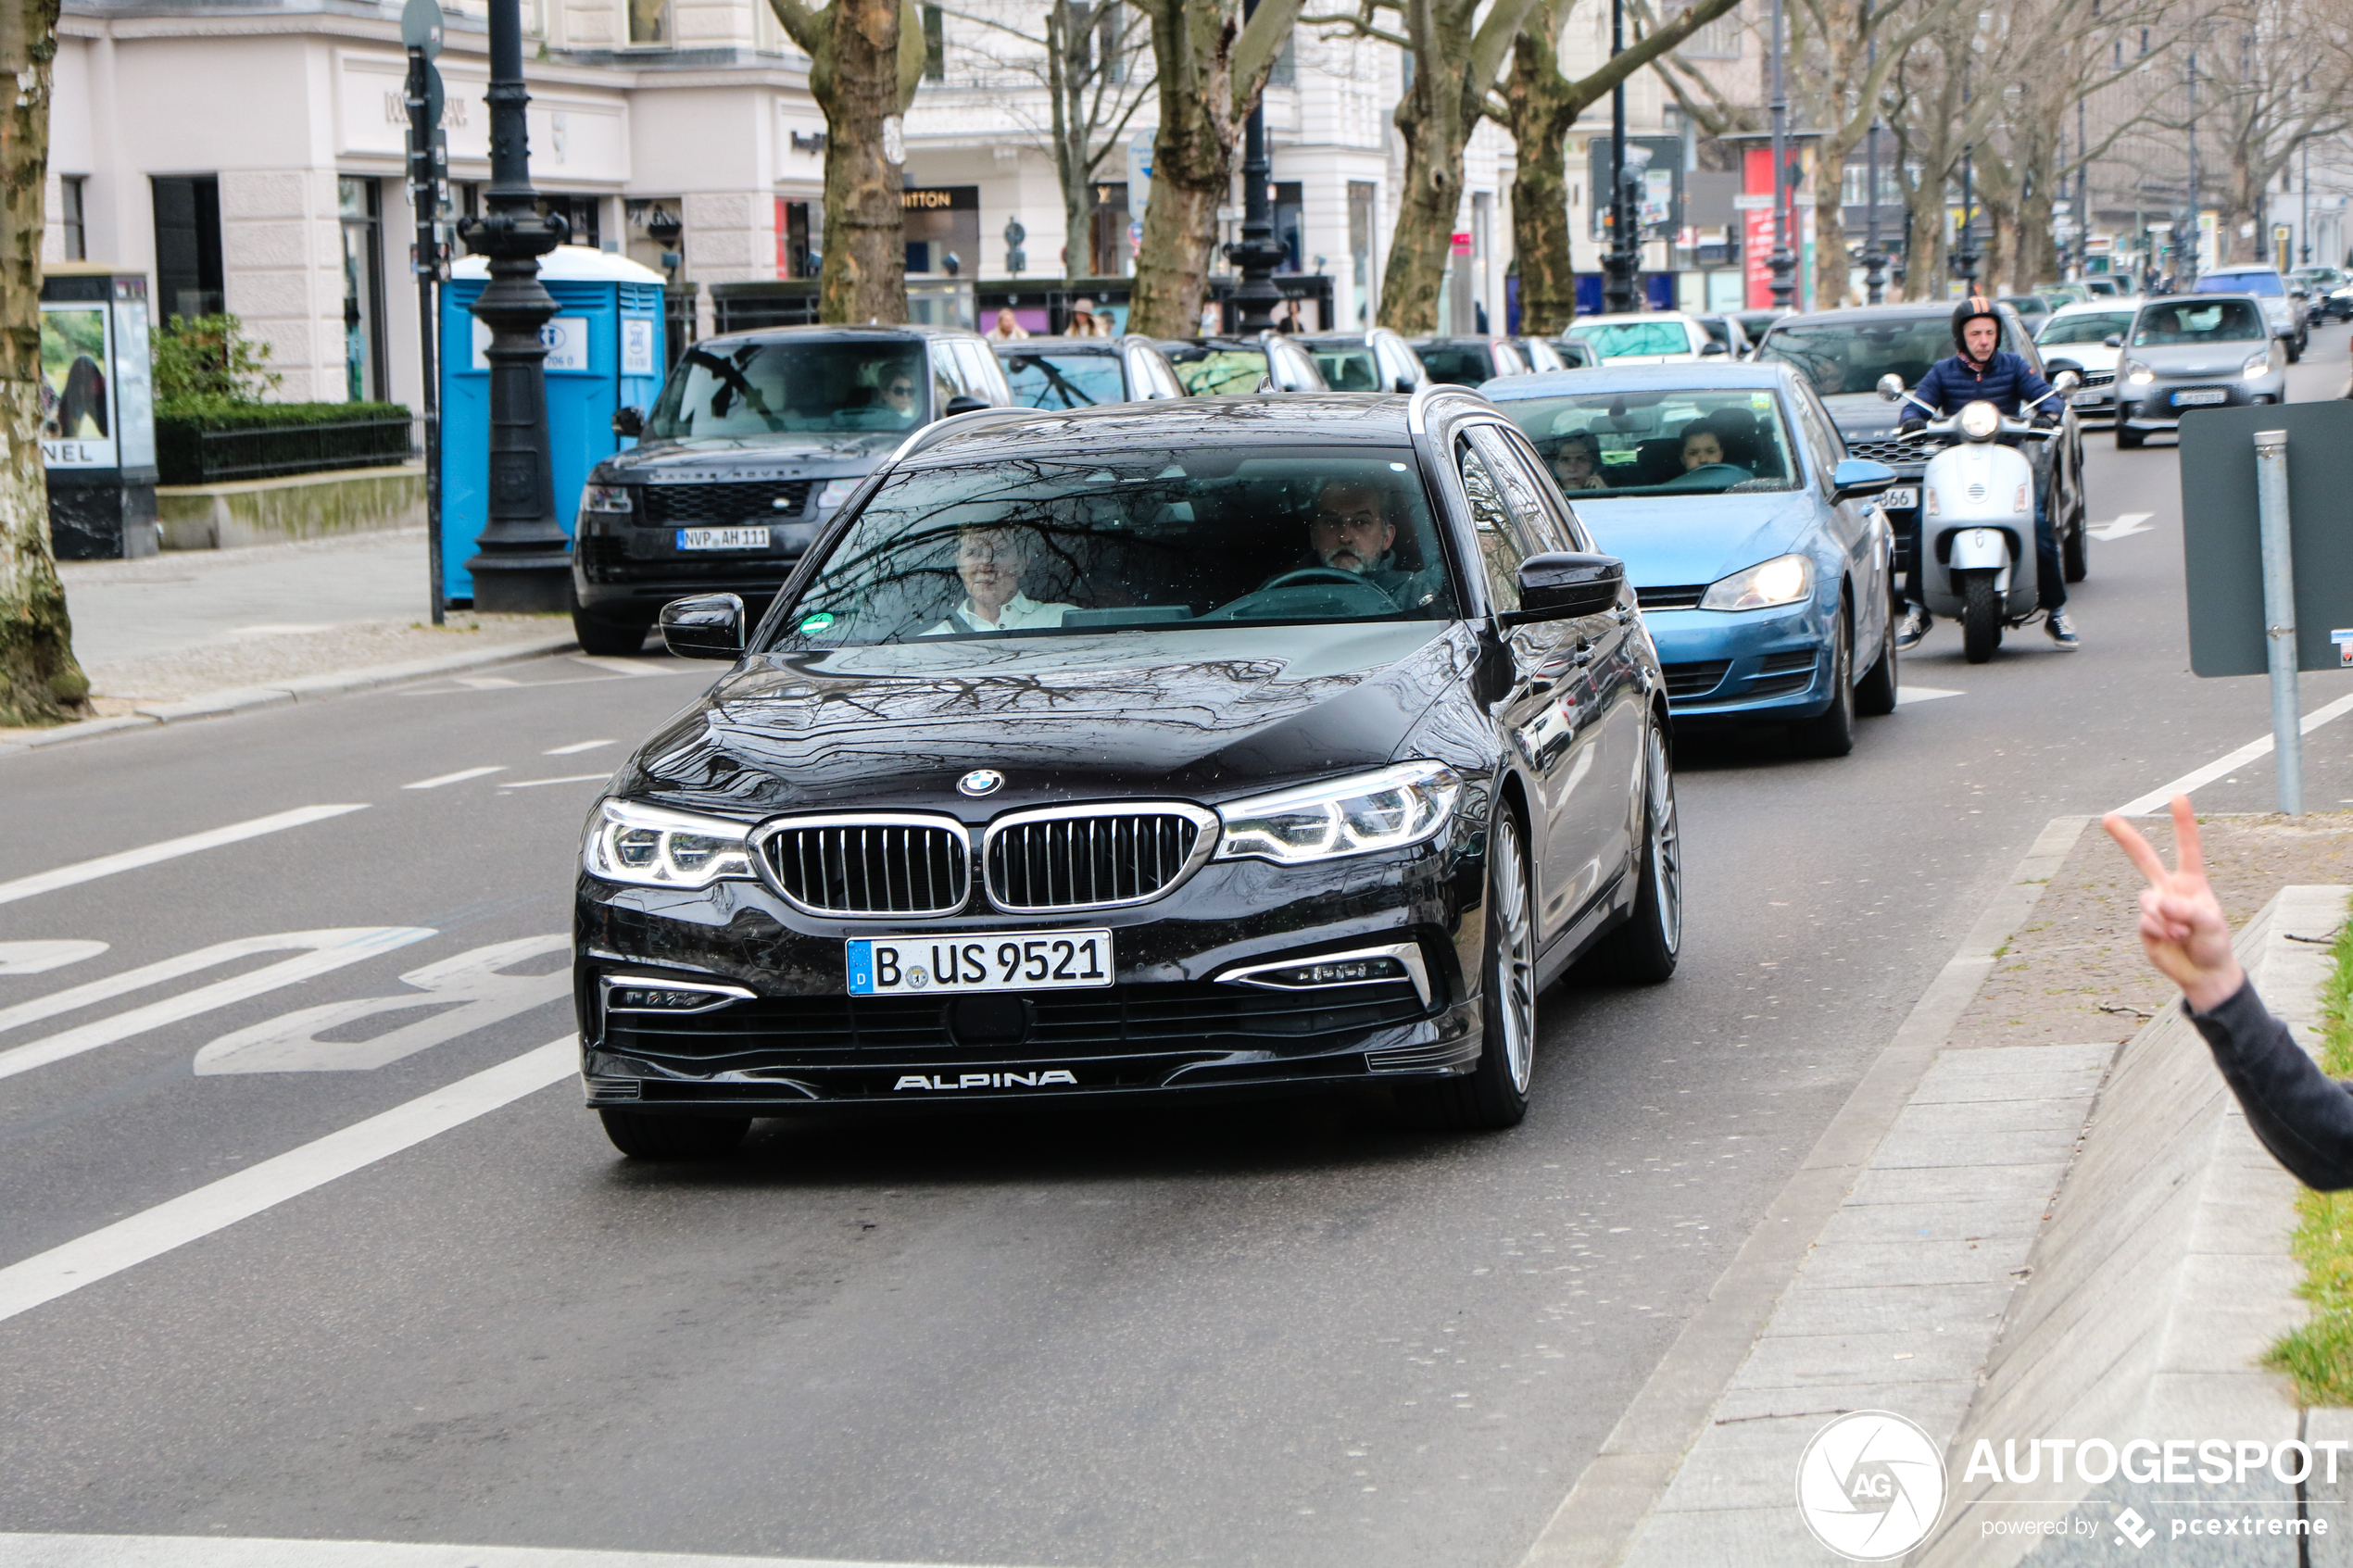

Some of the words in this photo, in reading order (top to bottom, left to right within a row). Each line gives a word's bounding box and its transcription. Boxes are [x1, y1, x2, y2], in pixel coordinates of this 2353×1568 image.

[44, 445, 93, 462] NEL
[686, 532, 711, 546] NVP
[722, 532, 738, 544] AH
[743, 530, 766, 546] 111
[875, 947, 901, 987] B
[932, 944, 987, 984] US
[997, 938, 1104, 983] 9521
[894, 1070, 1077, 1091] ALPINA
